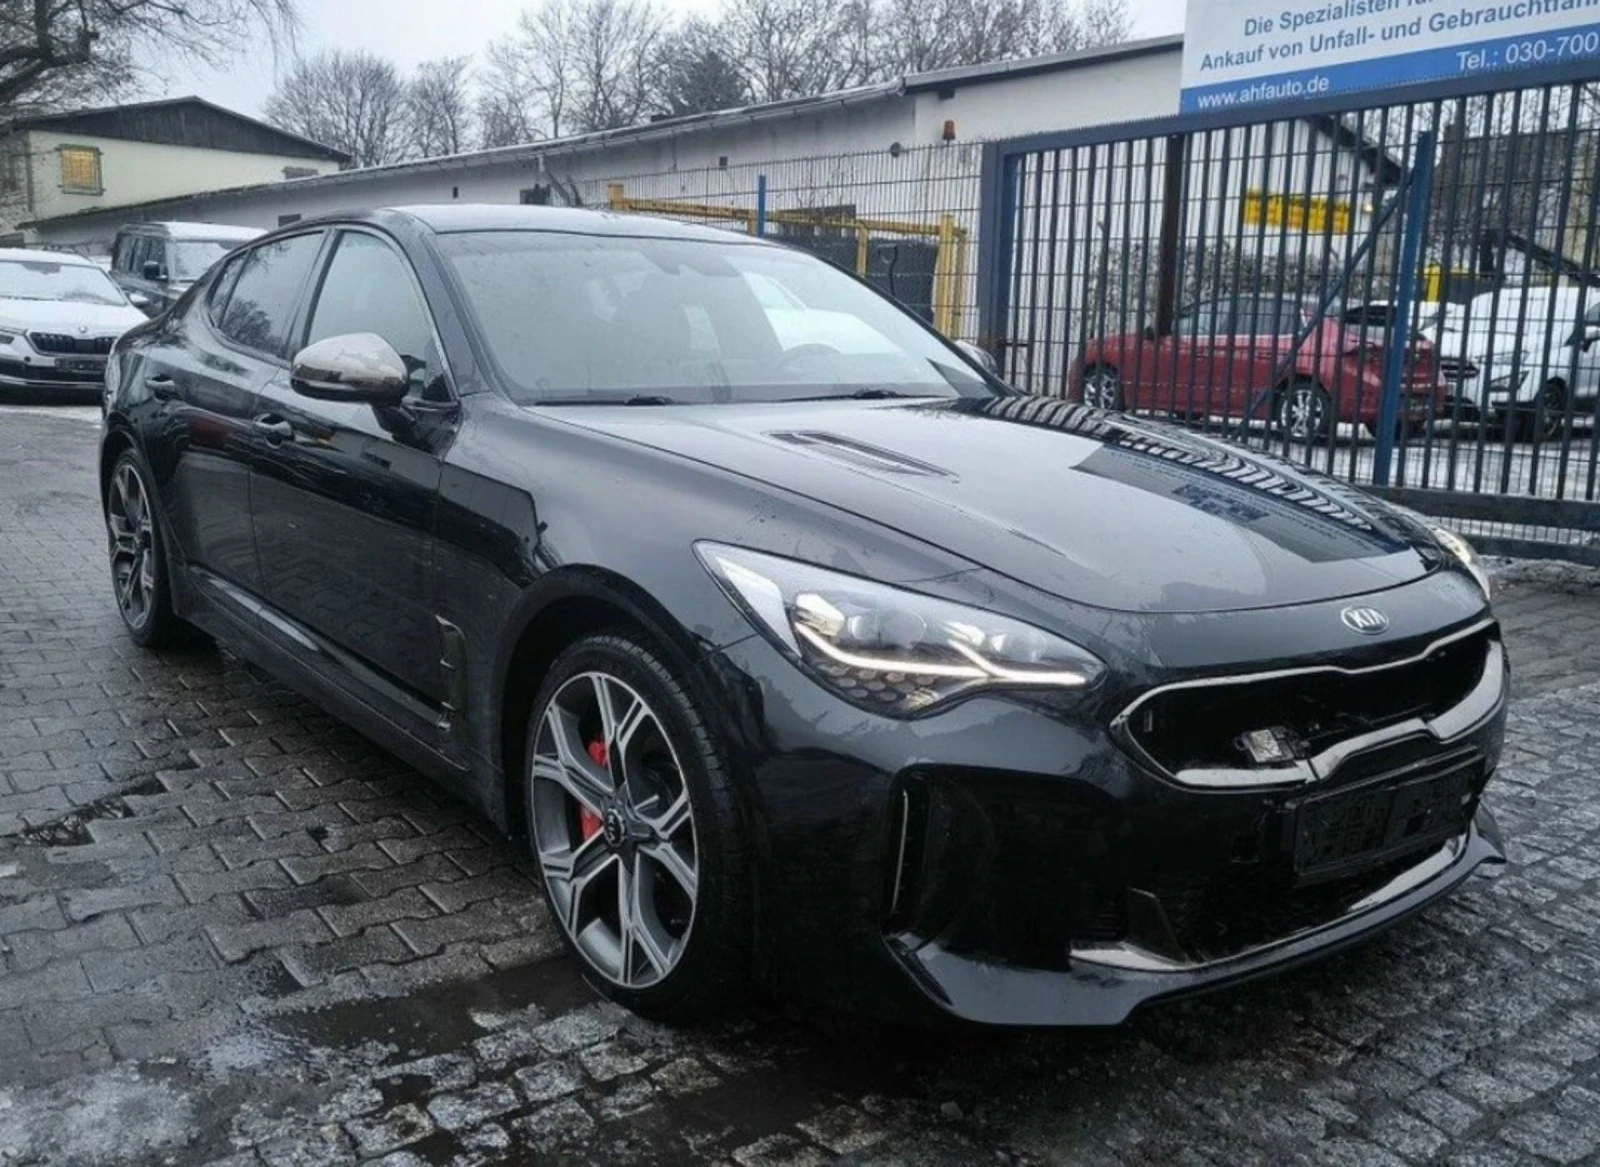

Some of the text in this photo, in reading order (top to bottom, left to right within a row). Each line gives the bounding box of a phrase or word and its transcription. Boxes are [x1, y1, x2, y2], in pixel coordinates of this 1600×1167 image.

[1243, 0, 1399, 37] Die Spezialisten
[1200, 44, 1265, 71] Ankauf
[1268, 41, 1303, 60] von
[1309, 26, 1375, 53] Unfall-
[1381, 16, 1422, 42] und
[1456, 31, 1599, 72] Tel.: 030-700
[1197, 75, 1330, 109] www.ahfauto.de
[1346, 608, 1387, 628] KIA
